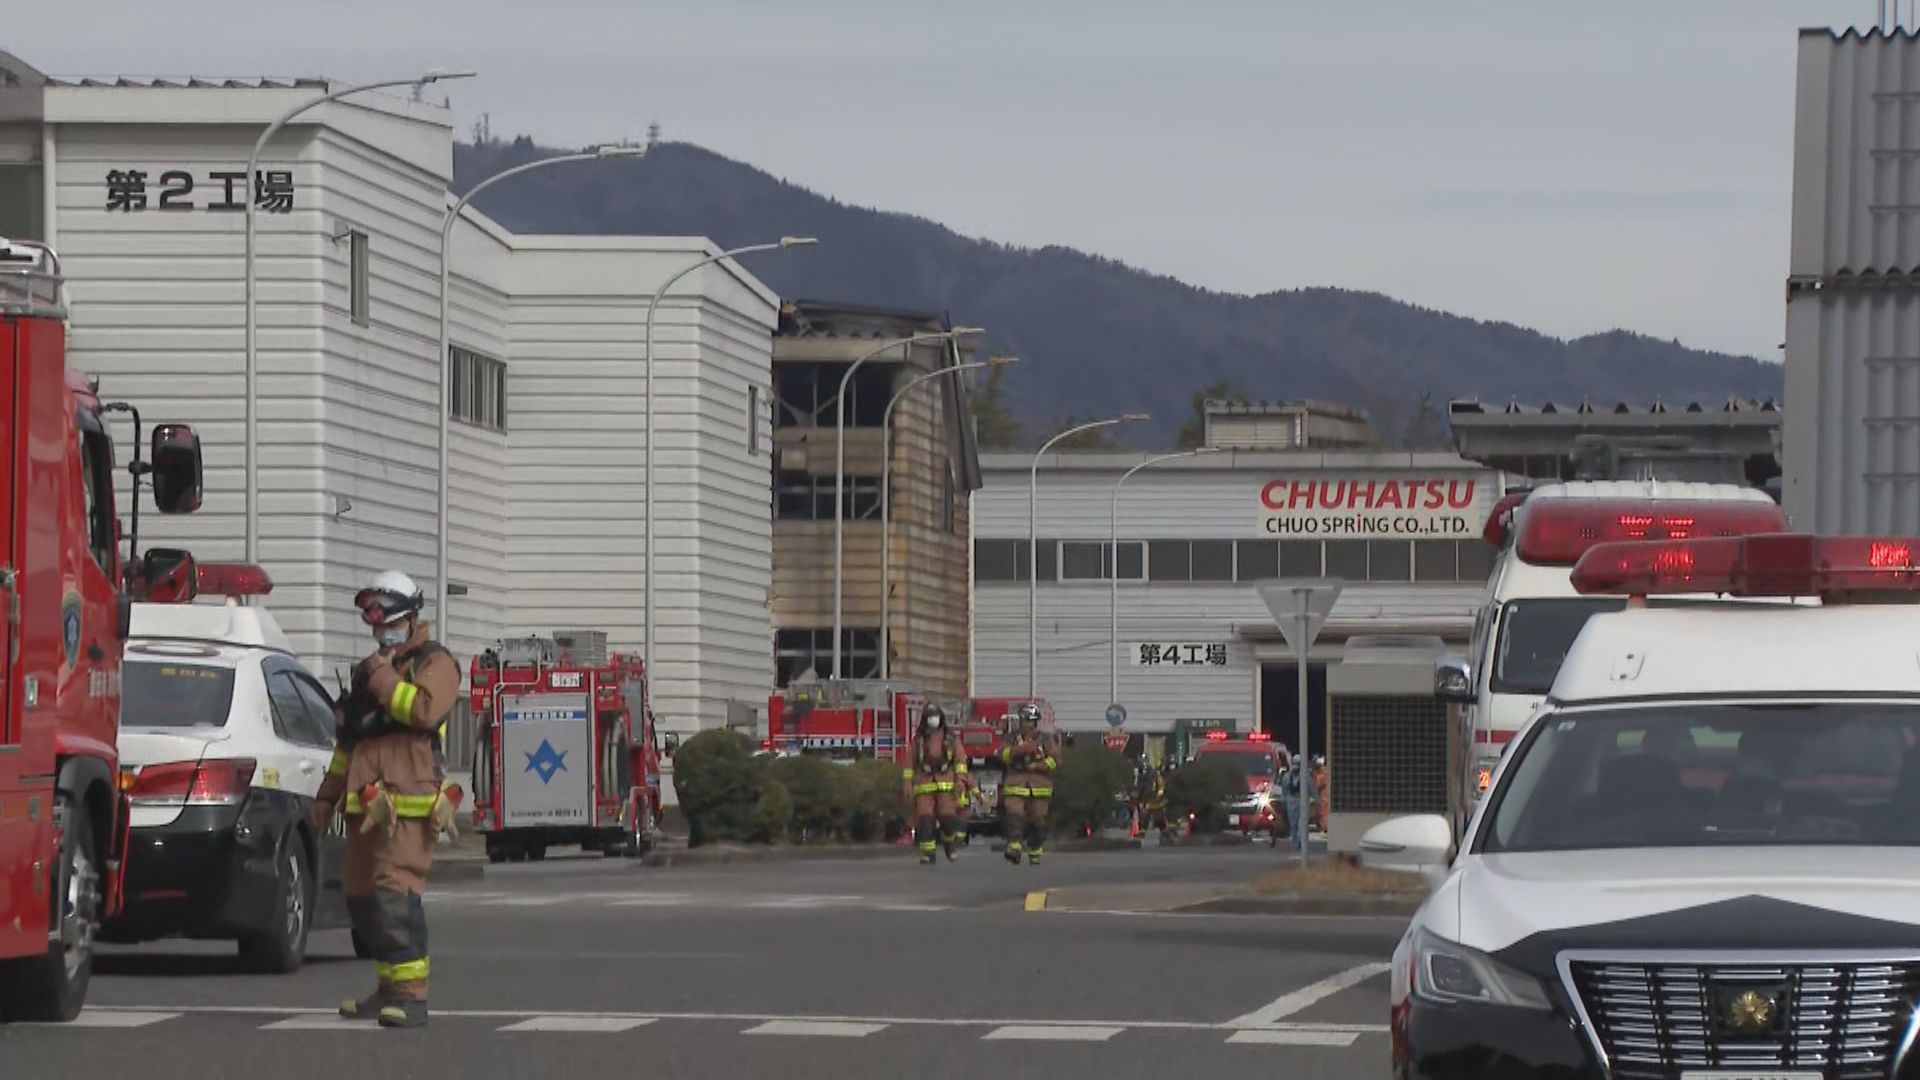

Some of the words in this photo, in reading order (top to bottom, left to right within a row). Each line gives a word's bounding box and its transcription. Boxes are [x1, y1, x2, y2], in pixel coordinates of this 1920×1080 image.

[105, 169, 294, 213] 第2工場
[1260, 479, 1475, 510] CHUHATSU
[1265, 516, 1318, 533] CHUO
[1140, 643, 1227, 665] 第4工場
